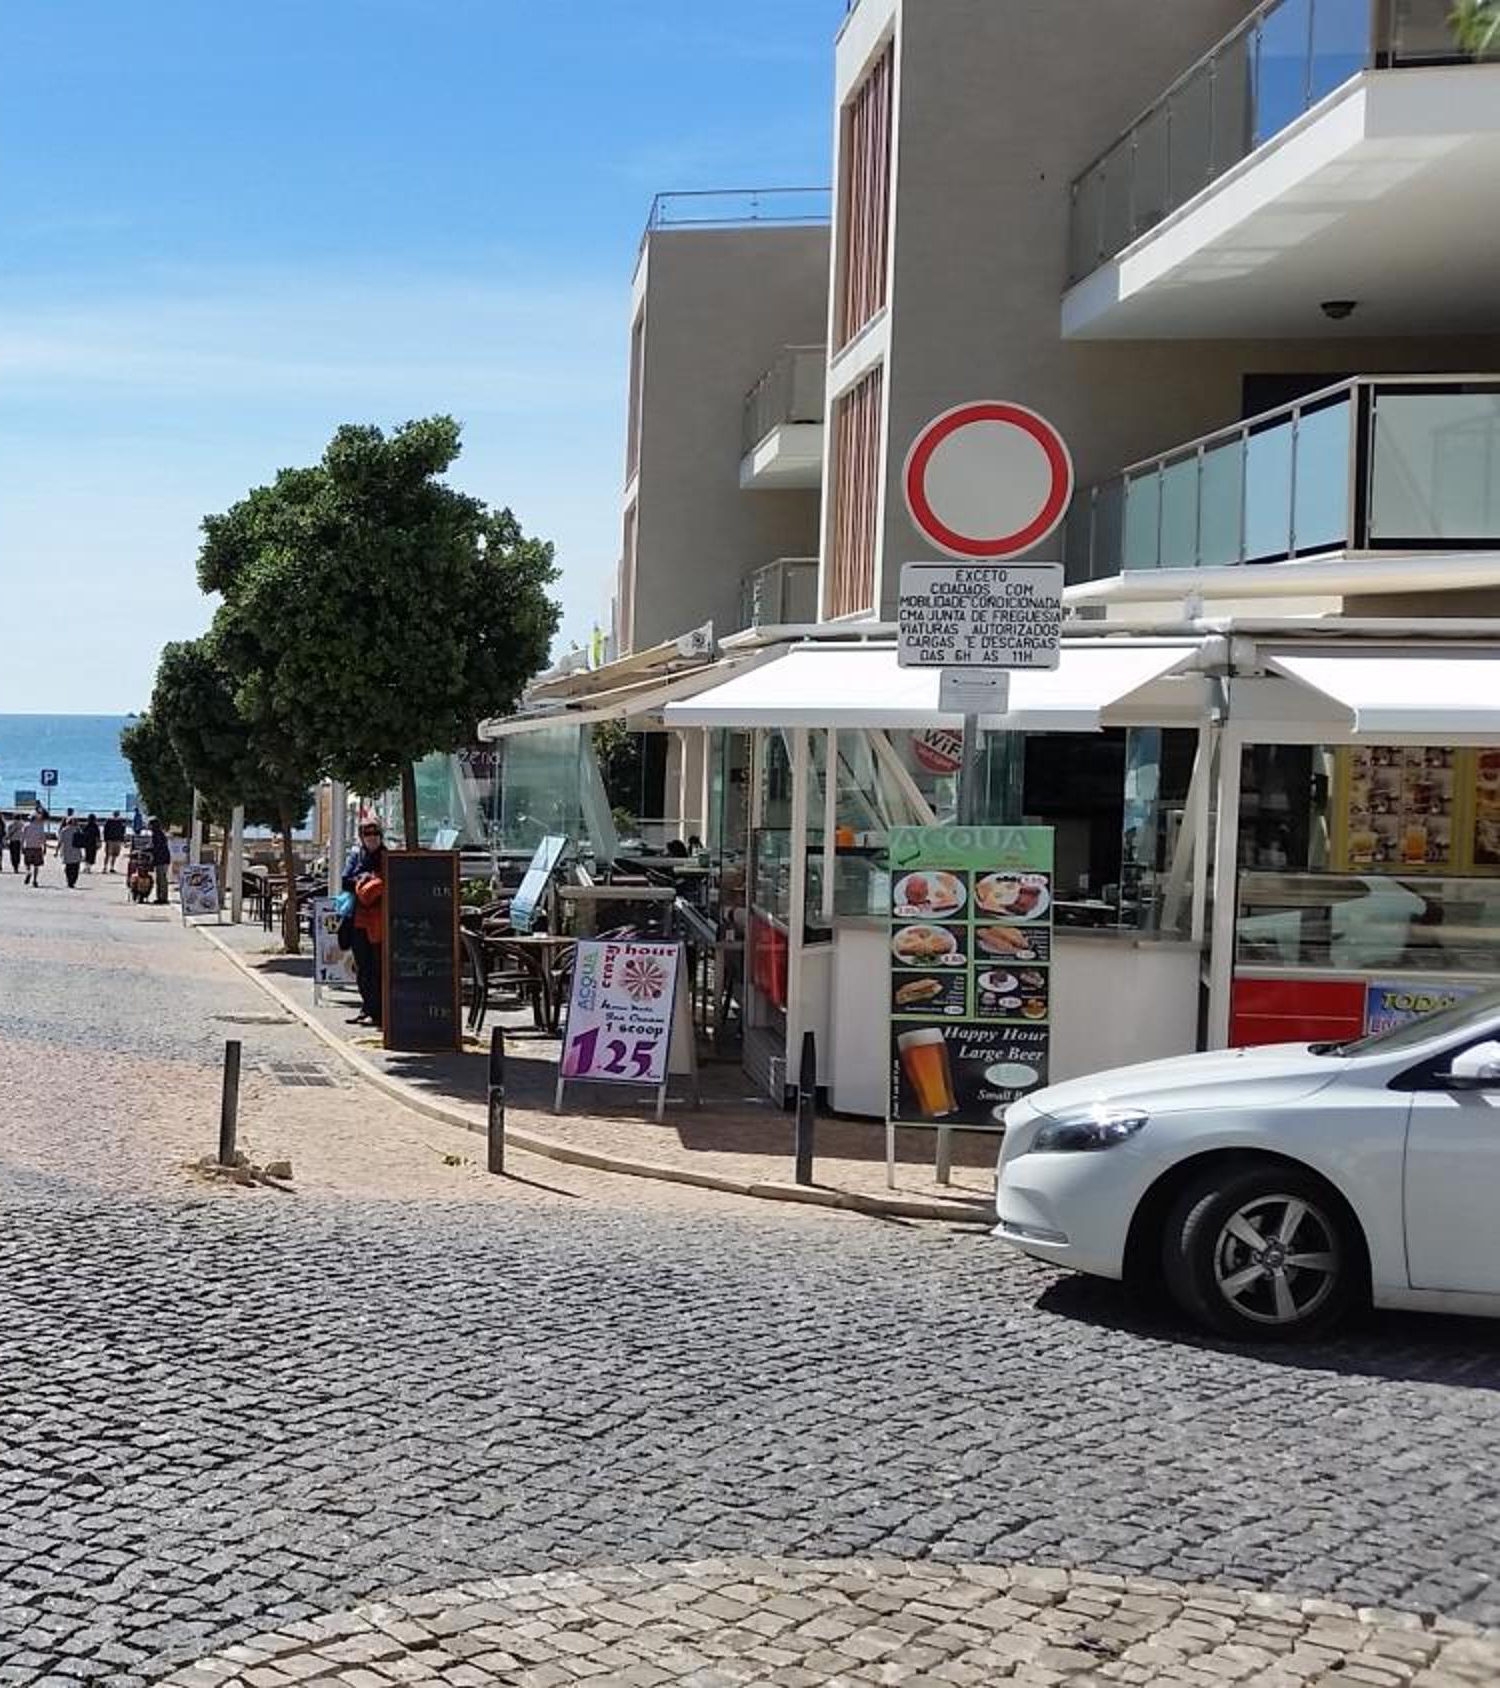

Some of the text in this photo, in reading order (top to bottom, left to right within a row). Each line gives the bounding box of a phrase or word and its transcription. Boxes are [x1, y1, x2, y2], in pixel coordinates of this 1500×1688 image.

[955, 569, 1008, 582] EXCETO
[1005, 584, 1034, 596] COM
[899, 595, 1060, 609] MOBILIDADE CONDICIONADA
[928, 610, 966, 622] JUNTA
[971, 610, 987, 622] DE
[993, 610, 1060, 622] FREGUESIA
[900, 623, 1059, 636] VIATURAS AUTORIZADOS
[906, 636, 955, 648] CARGAS
[981, 636, 1056, 649] DESCARGAS
[920, 650, 945, 661] DAS
[43, 771, 55, 784] P
[625, 944, 677, 957] hour
[619, 1024, 663, 1040] scoop
[943, 1026, 1048, 1041] Happy Hour
[958, 1045, 1044, 1061] Large Beer
[977, 1089, 1010, 1100] Small
